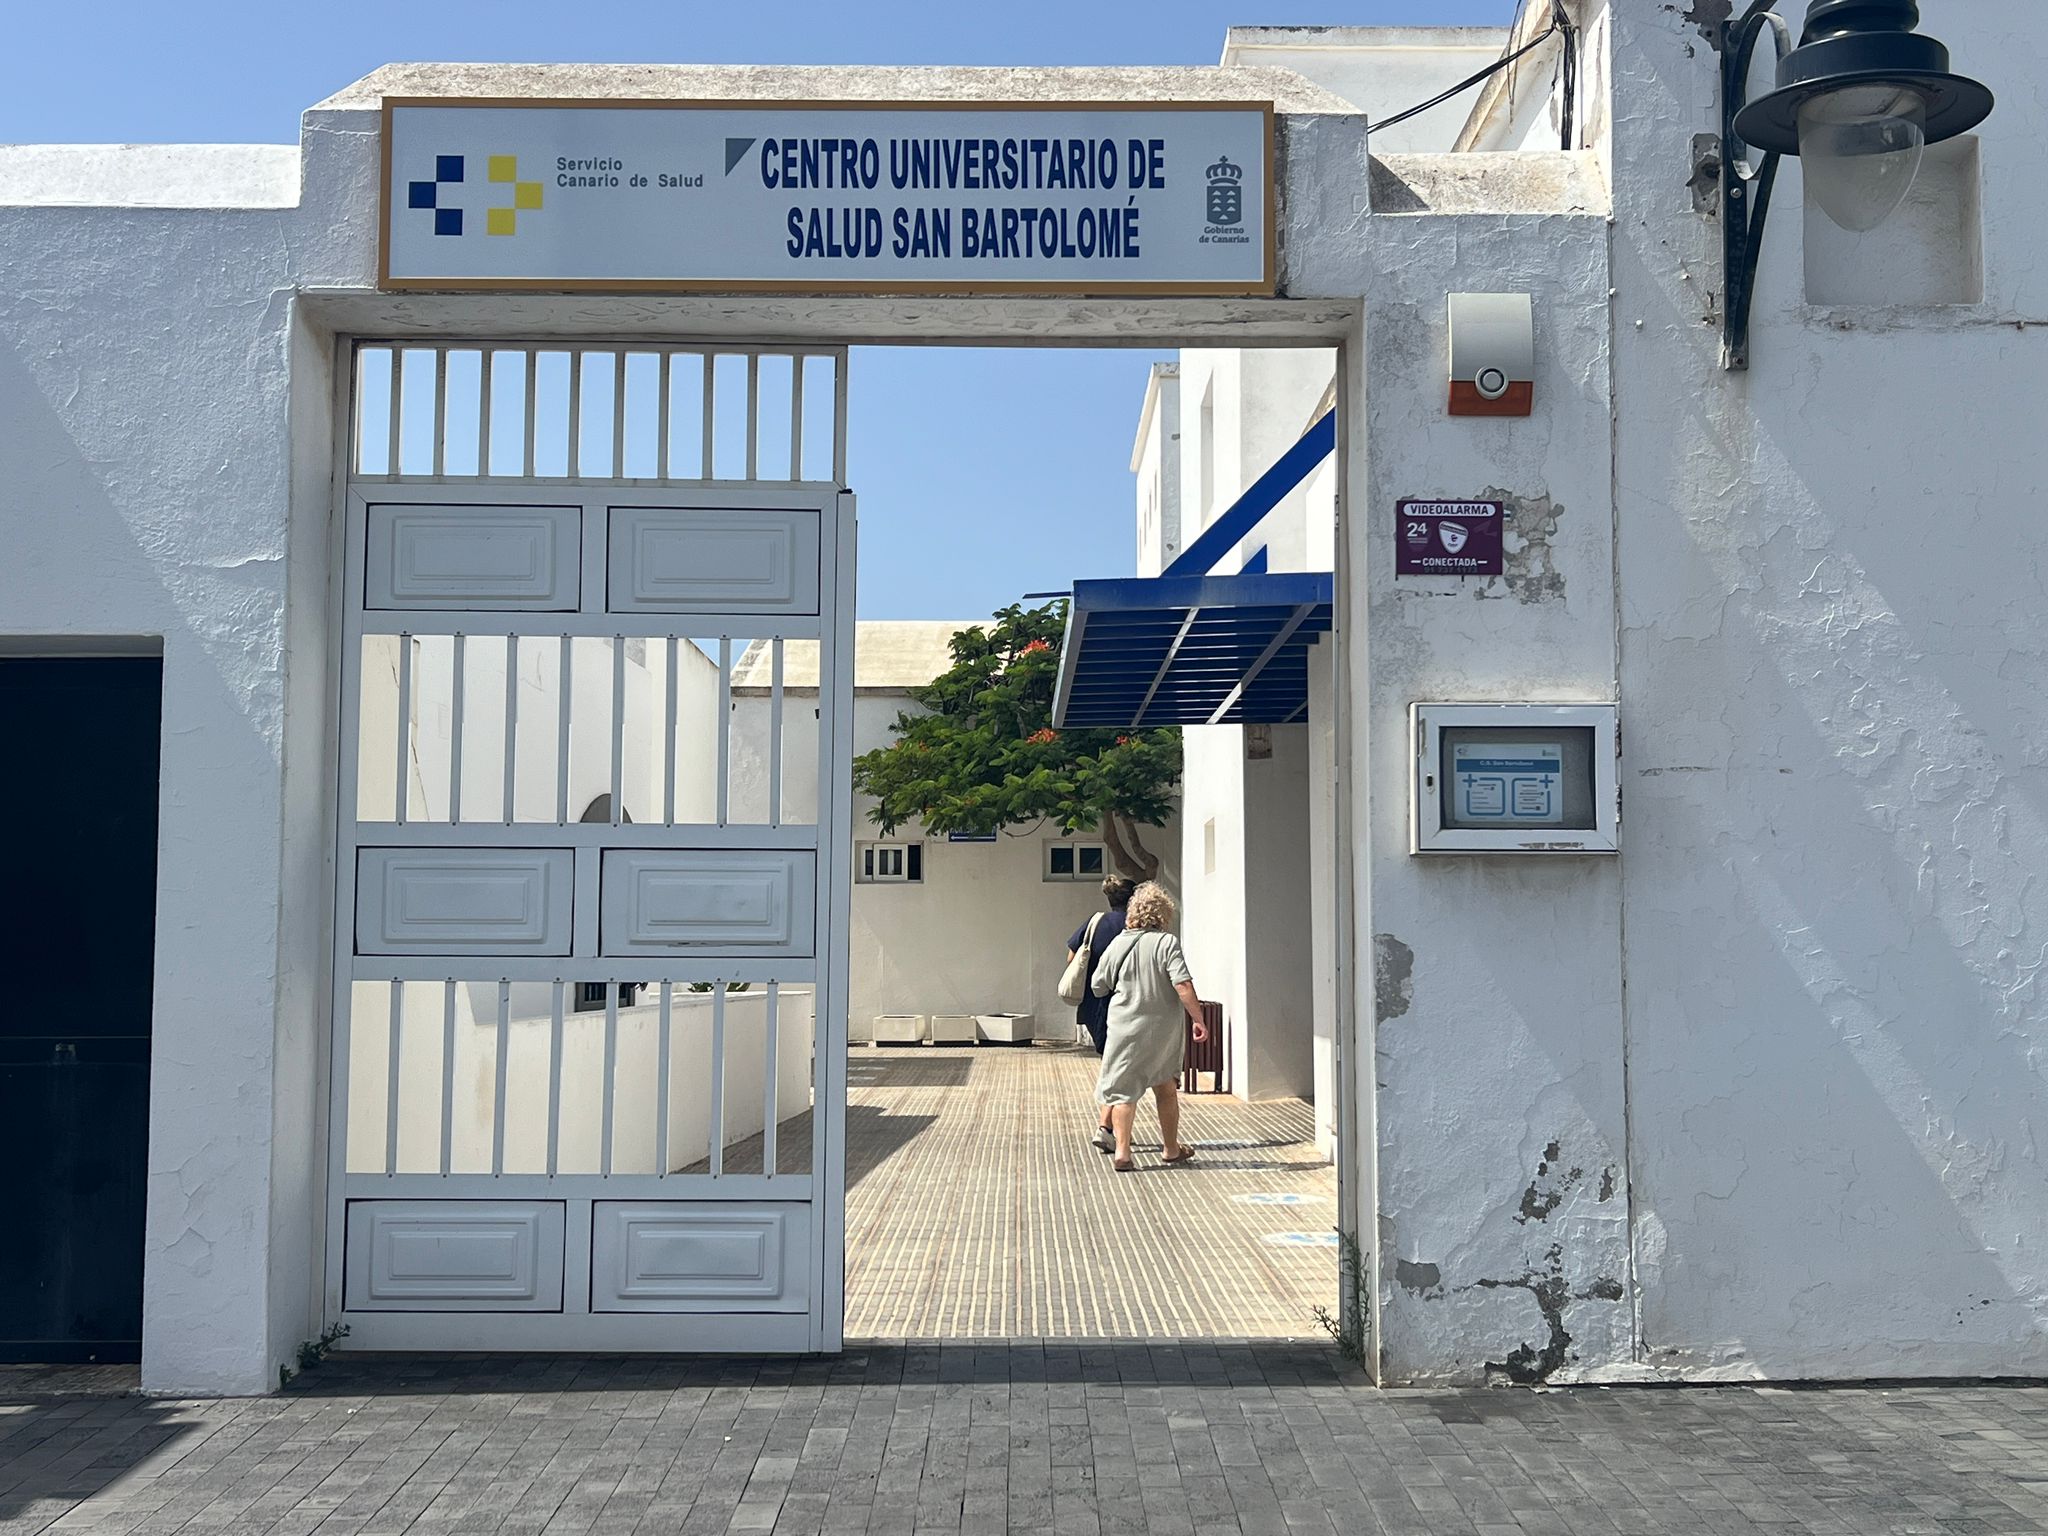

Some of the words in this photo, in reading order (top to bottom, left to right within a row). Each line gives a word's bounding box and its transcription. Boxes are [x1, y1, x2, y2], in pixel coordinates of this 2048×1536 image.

[556, 156, 623, 171] Servicio
[762, 138, 881, 190] CENTRO
[889, 138, 1119, 191] UNIVERSITARIO
[1127, 138, 1165, 190] DE
[556, 173, 619, 188] Canario
[629, 173, 649, 188] de
[658, 173, 704, 188] Salud
[786, 206, 884, 259] SALUD
[892, 206, 951, 259] SAN
[961, 195, 1140, 259] BARTOLOMÉ
[1203, 225, 1245, 234] Gobierno
[1198, 235, 1210, 243] de
[1211, 235, 1250, 243] Canarias
[1410, 504, 1489, 515] VIDEOALARMA
[1407, 522, 1428, 537] 24
[1422, 557, 1477, 567] CONECTADA
